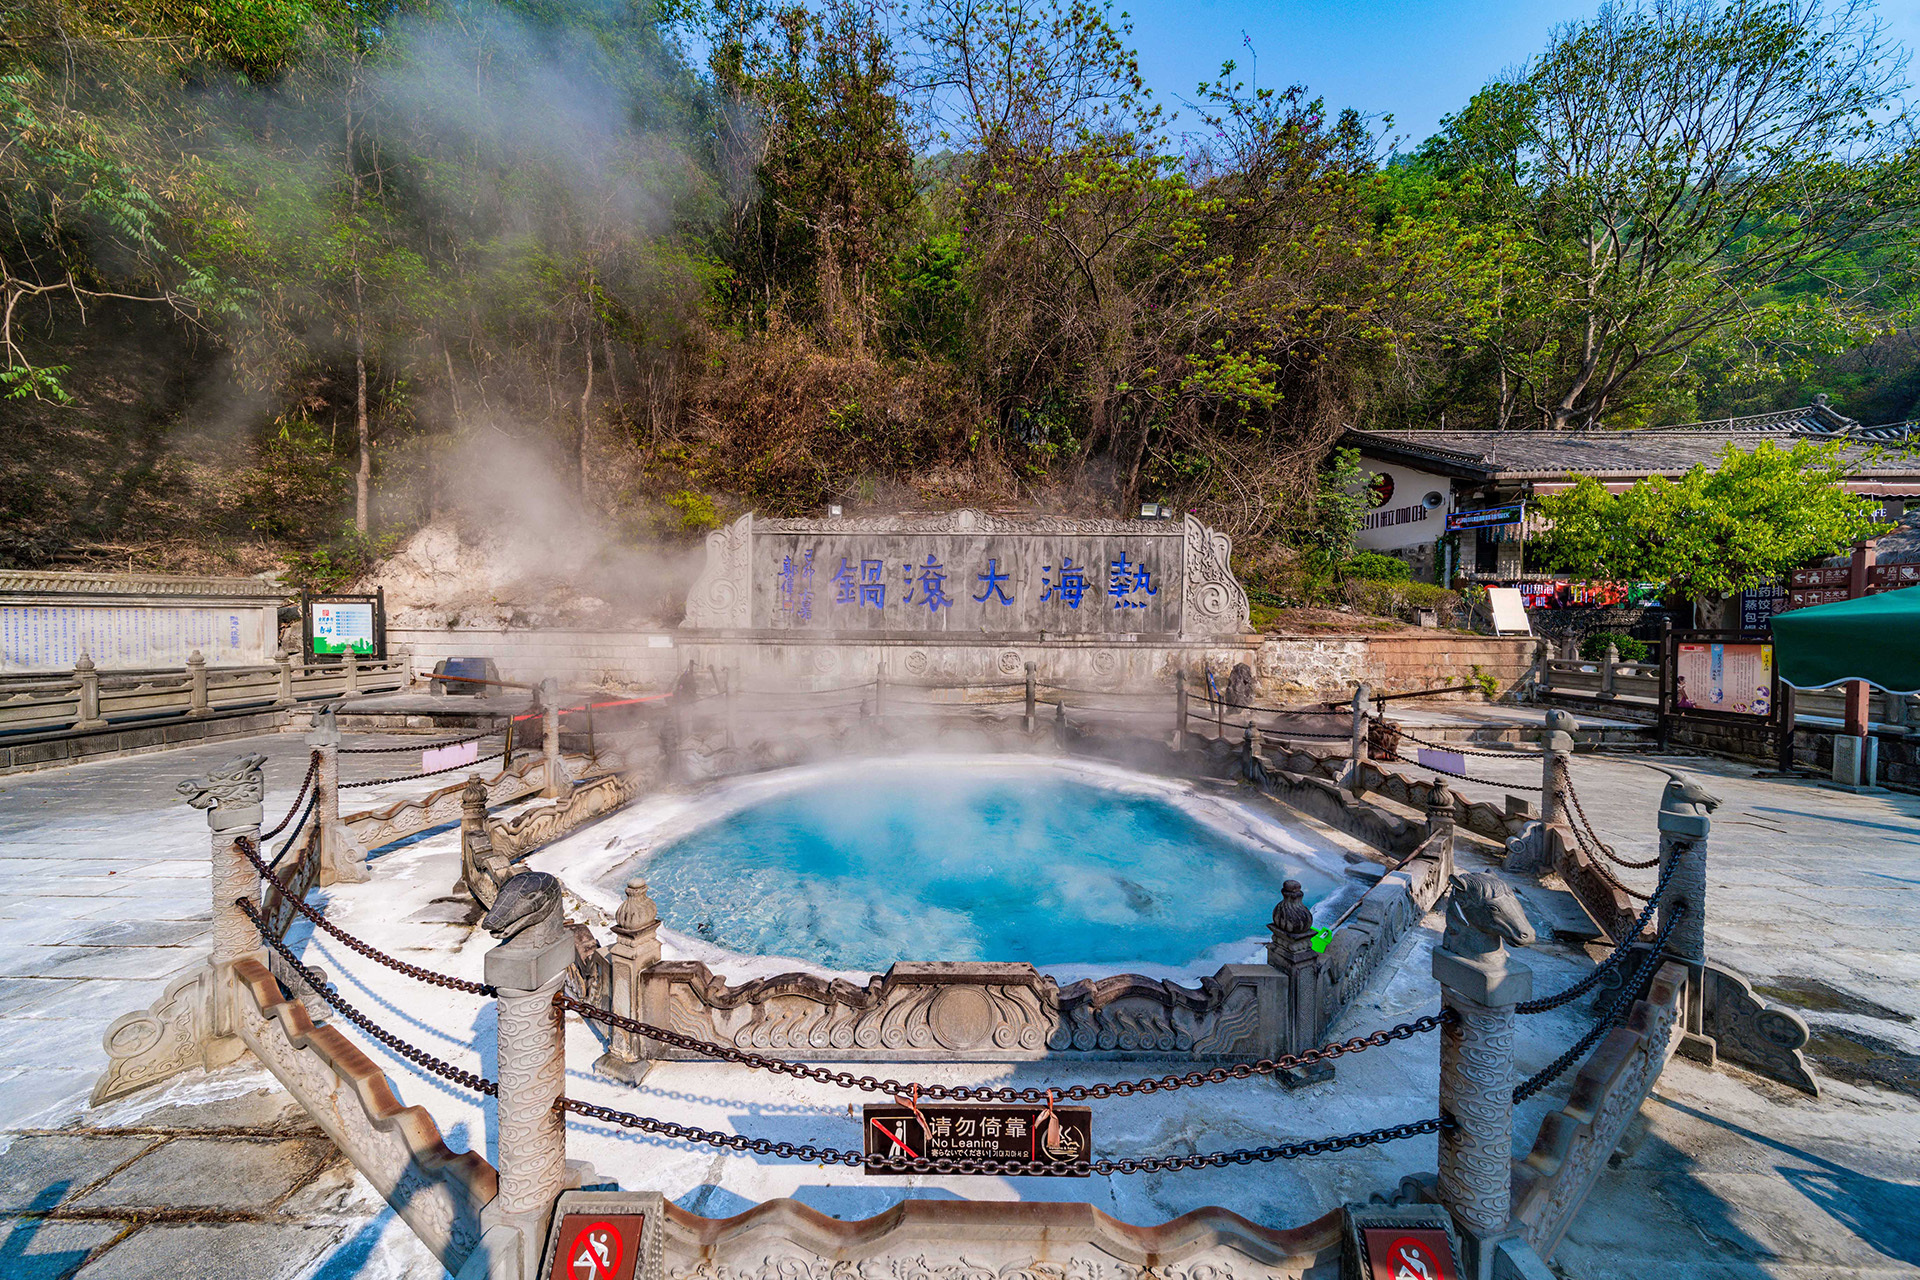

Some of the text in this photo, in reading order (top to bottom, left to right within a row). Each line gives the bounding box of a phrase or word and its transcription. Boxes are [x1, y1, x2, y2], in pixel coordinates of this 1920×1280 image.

[1745, 599, 1771, 611] 蒸饺
[1745, 612, 1771, 623] 包子
[929, 1116, 1027, 1138] 请勿倚靠
[931, 1138, 999, 1150] No Leaning
